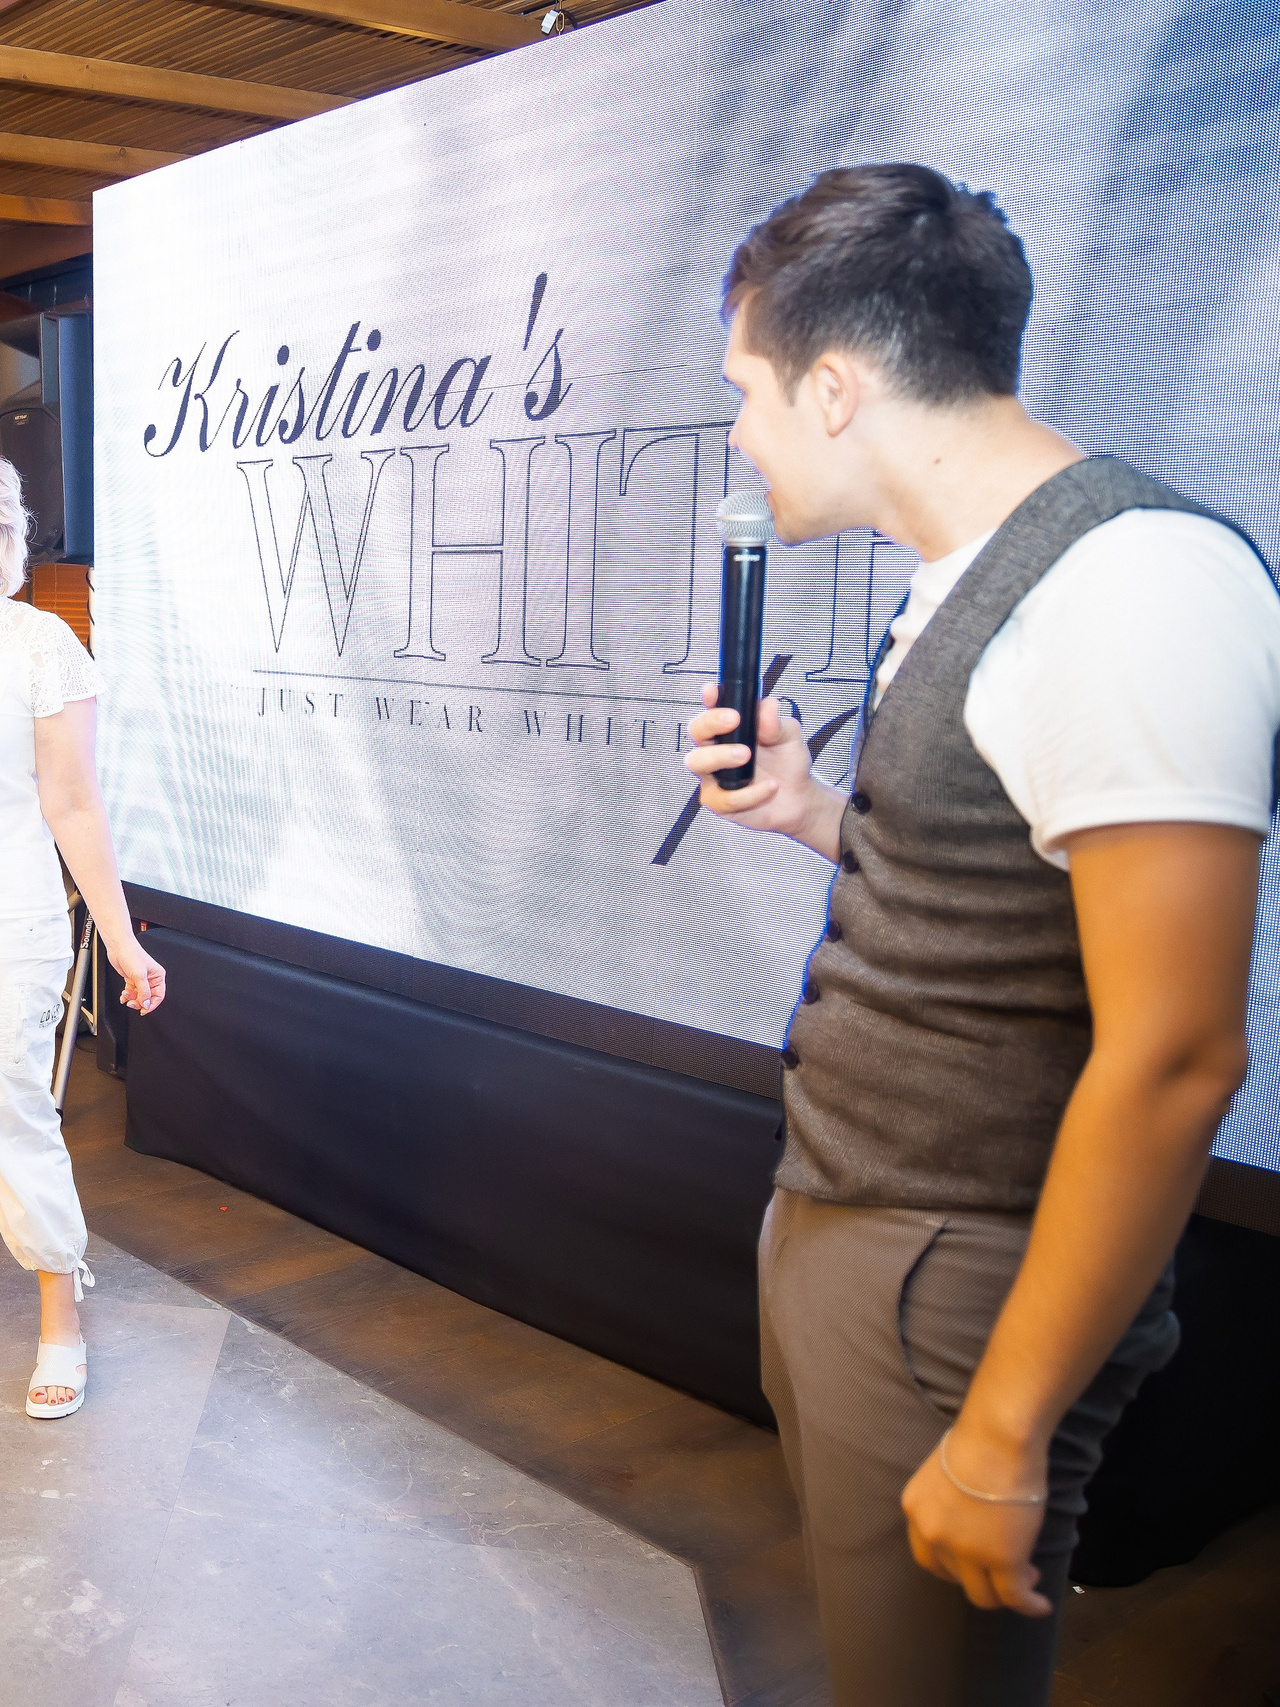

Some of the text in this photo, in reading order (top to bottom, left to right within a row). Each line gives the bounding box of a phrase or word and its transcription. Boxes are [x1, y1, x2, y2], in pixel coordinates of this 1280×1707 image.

[144, 272, 573, 458] Kristina's
[257, 687, 345, 718] JUST
[375, 696, 484, 733] WEAR
[80, 911, 95, 949] Soundkin
